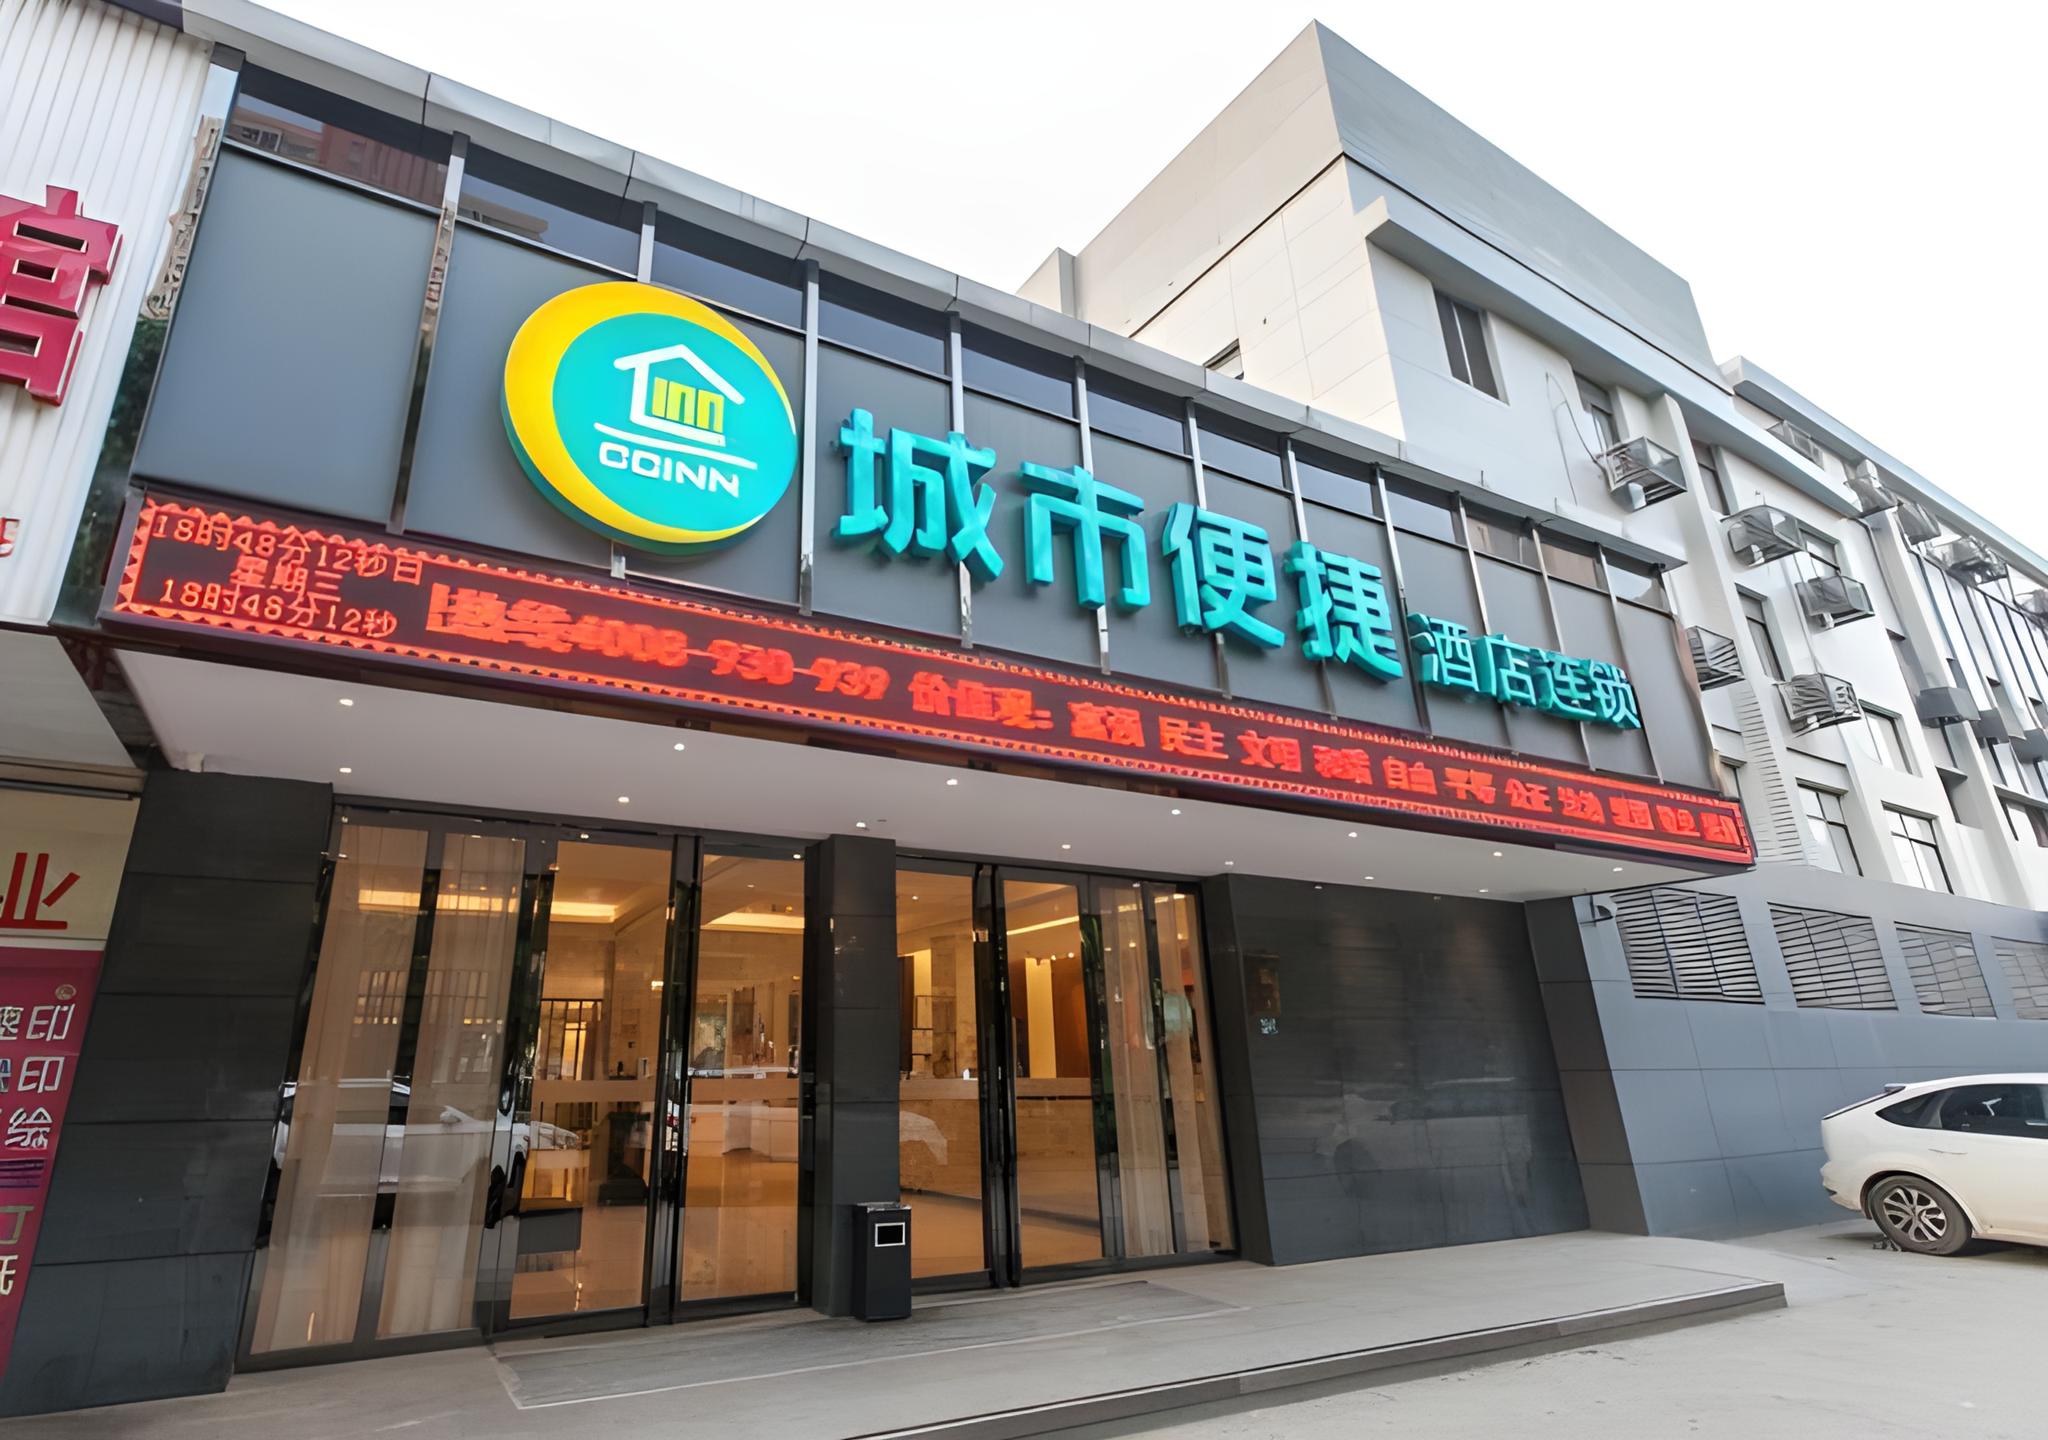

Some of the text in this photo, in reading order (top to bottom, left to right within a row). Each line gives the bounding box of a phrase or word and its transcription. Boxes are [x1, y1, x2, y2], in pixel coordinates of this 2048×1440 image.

[230, 553, 343, 602] 星期三
[834, 407, 1642, 730] 城市便捷 酒店连锁
[1158, 715, 1229, 760] 民主
